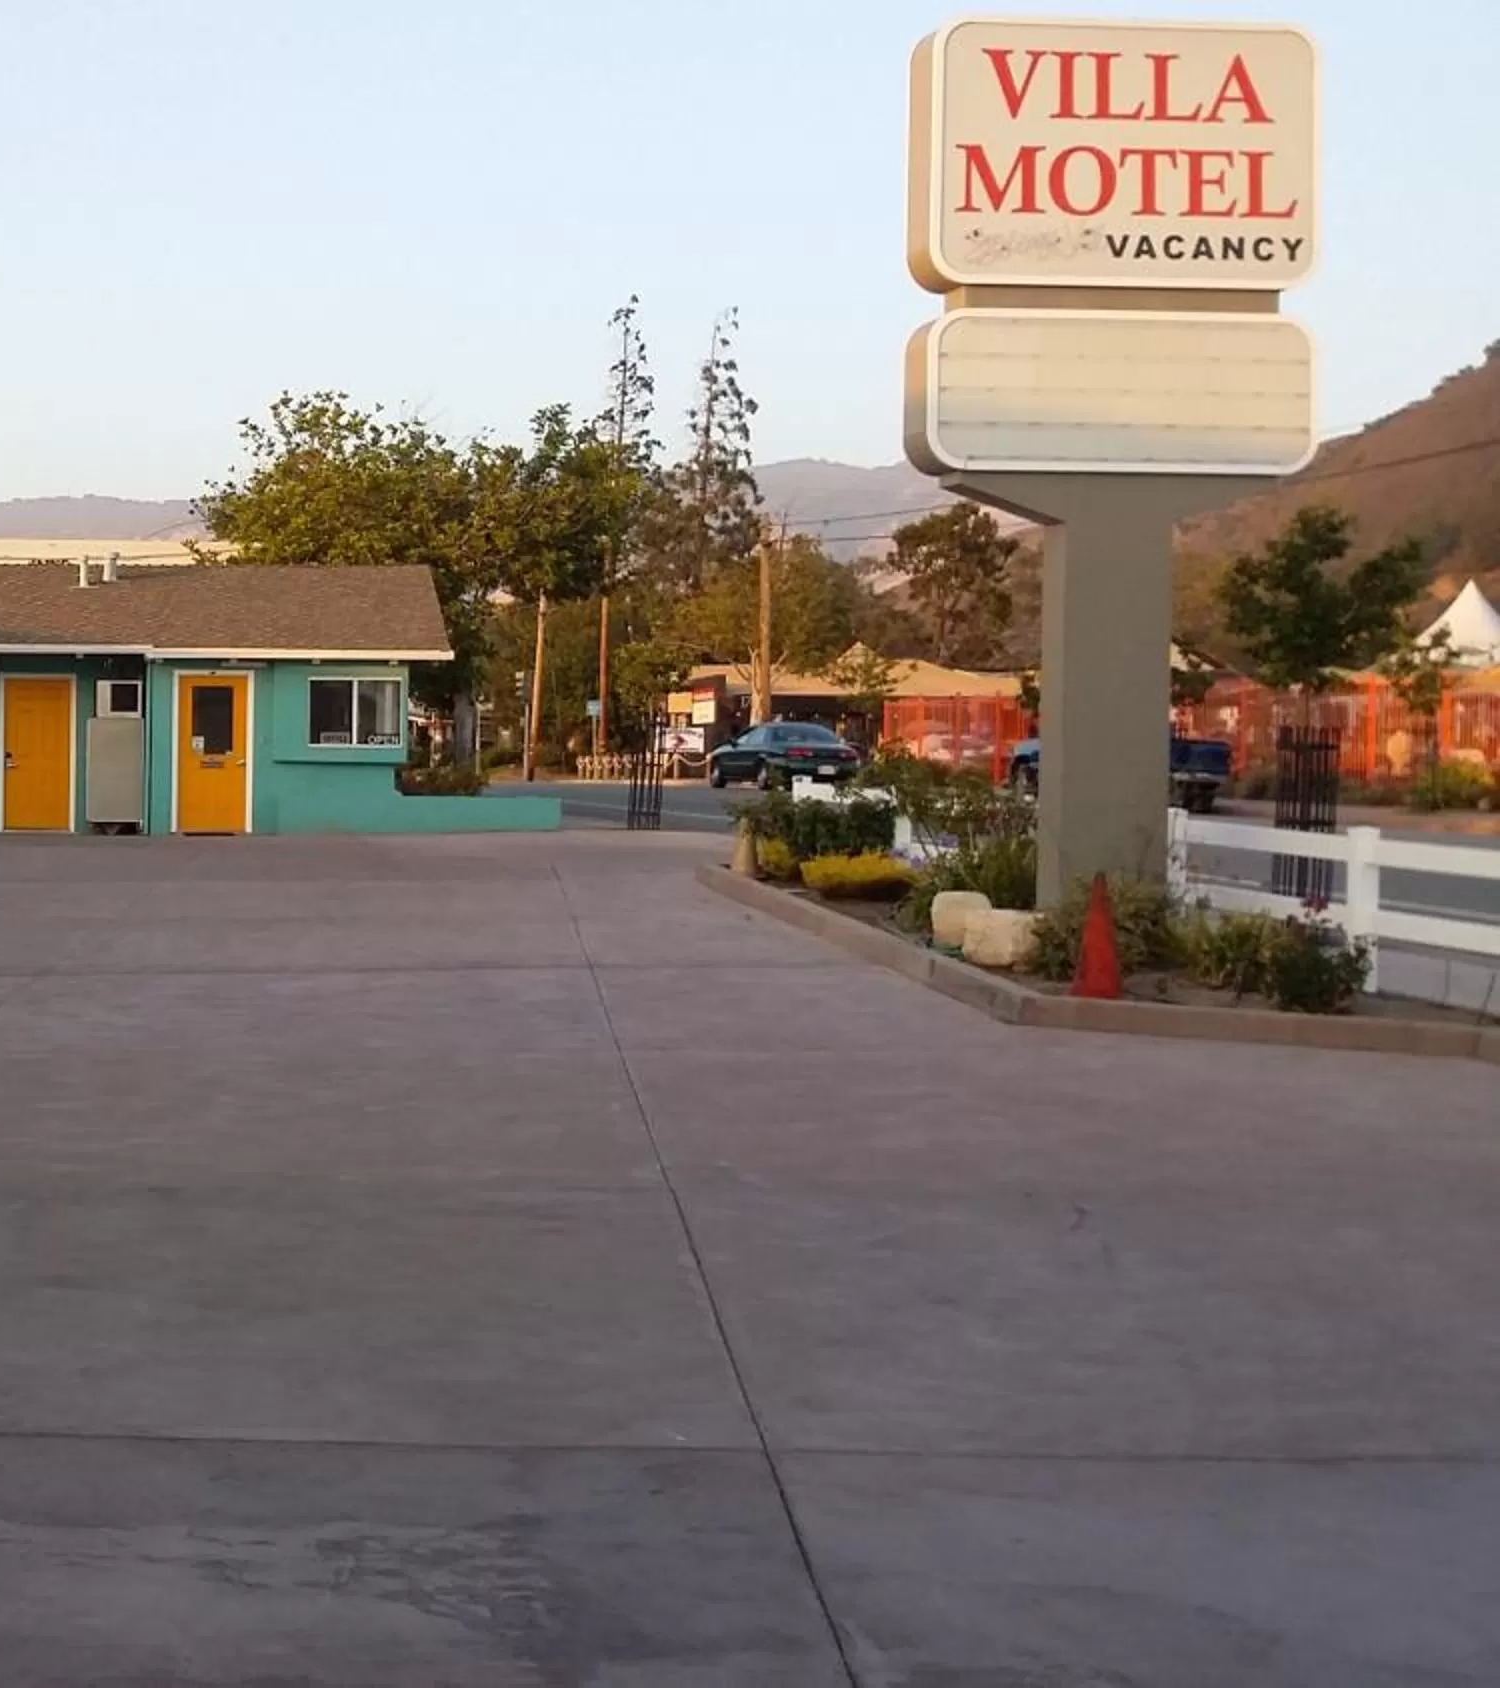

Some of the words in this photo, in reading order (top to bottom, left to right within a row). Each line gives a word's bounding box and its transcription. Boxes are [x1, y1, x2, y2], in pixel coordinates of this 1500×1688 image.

[982, 48, 1275, 124] VILLA
[955, 144, 1299, 219] MOTEL
[1106, 234, 1304, 262] VACANCY
[367, 735, 399, 746] OPEN
